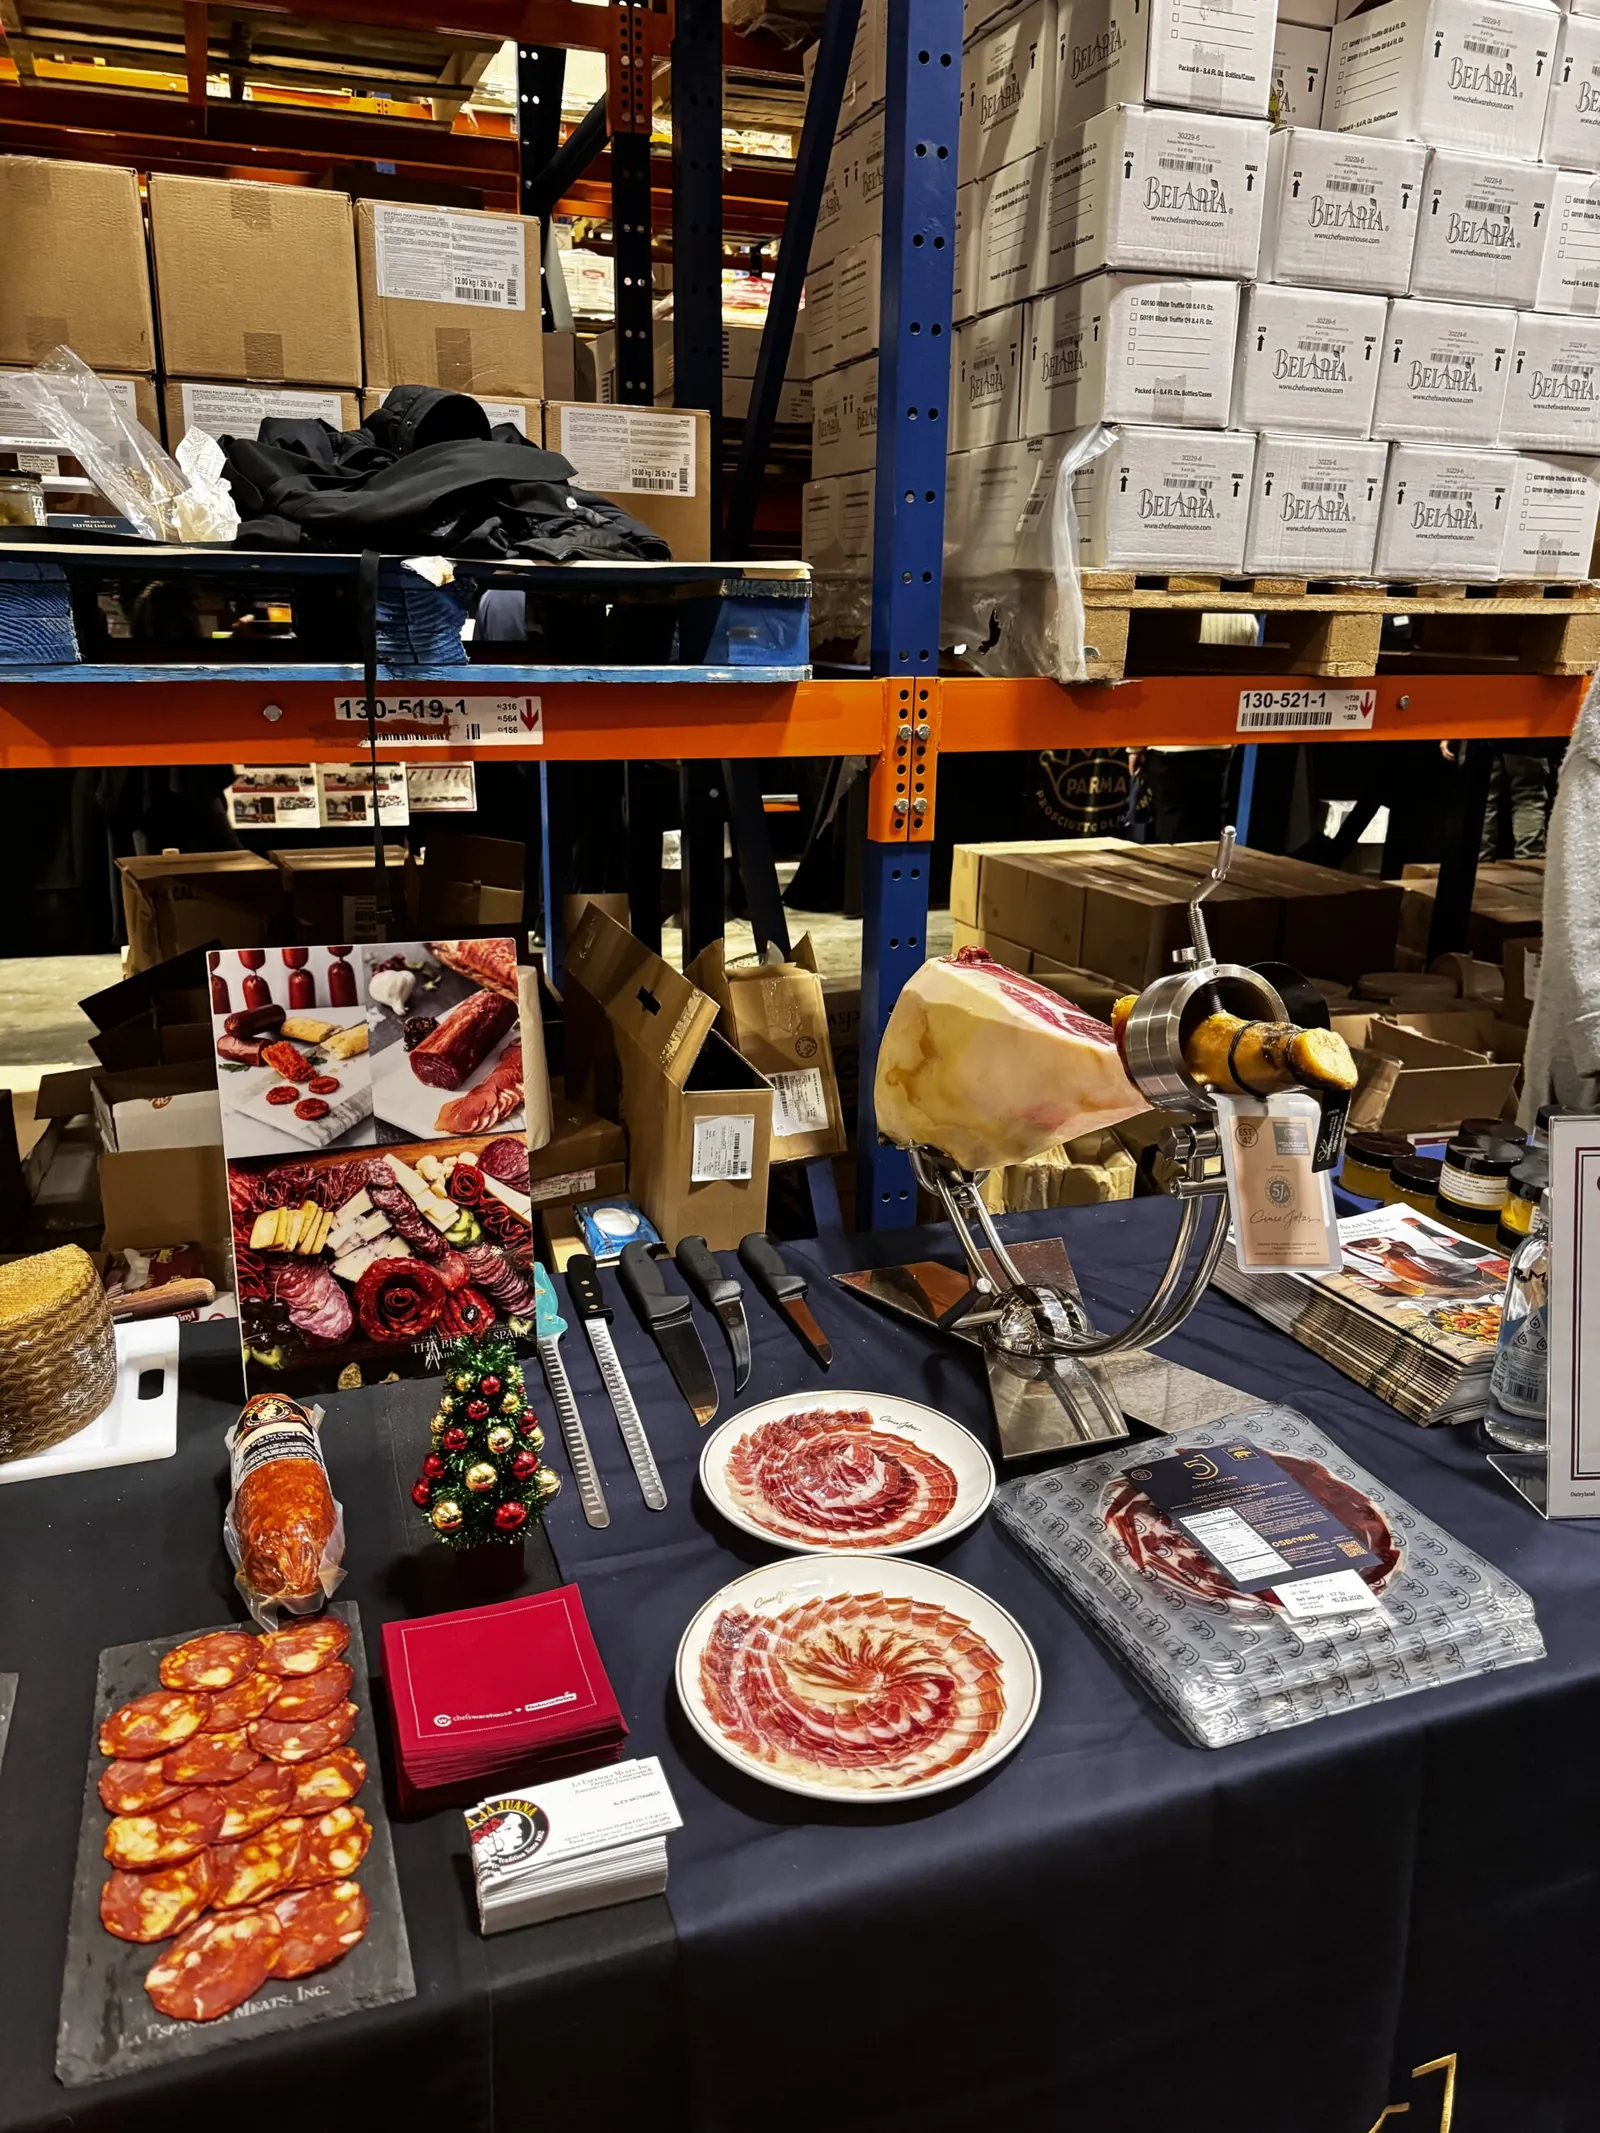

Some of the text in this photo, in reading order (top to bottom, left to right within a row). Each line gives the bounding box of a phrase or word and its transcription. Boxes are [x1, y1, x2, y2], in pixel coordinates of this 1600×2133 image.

[1151, 215, 1224, 227] www.chefswarehouse.com
[1314, 232, 1380, 244] www.chefswarehouse.com
[1144, 522, 1211, 531] www.chefswarehouse.com
[1243, 692, 1326, 708] 130-521-1
[1066, 776, 1126, 796] PARMA
[1271, 1533, 1318, 1547] OSBORNE
[497, 1799, 538, 1817] JUANA
[297, 1985, 330, 2001] INC.
